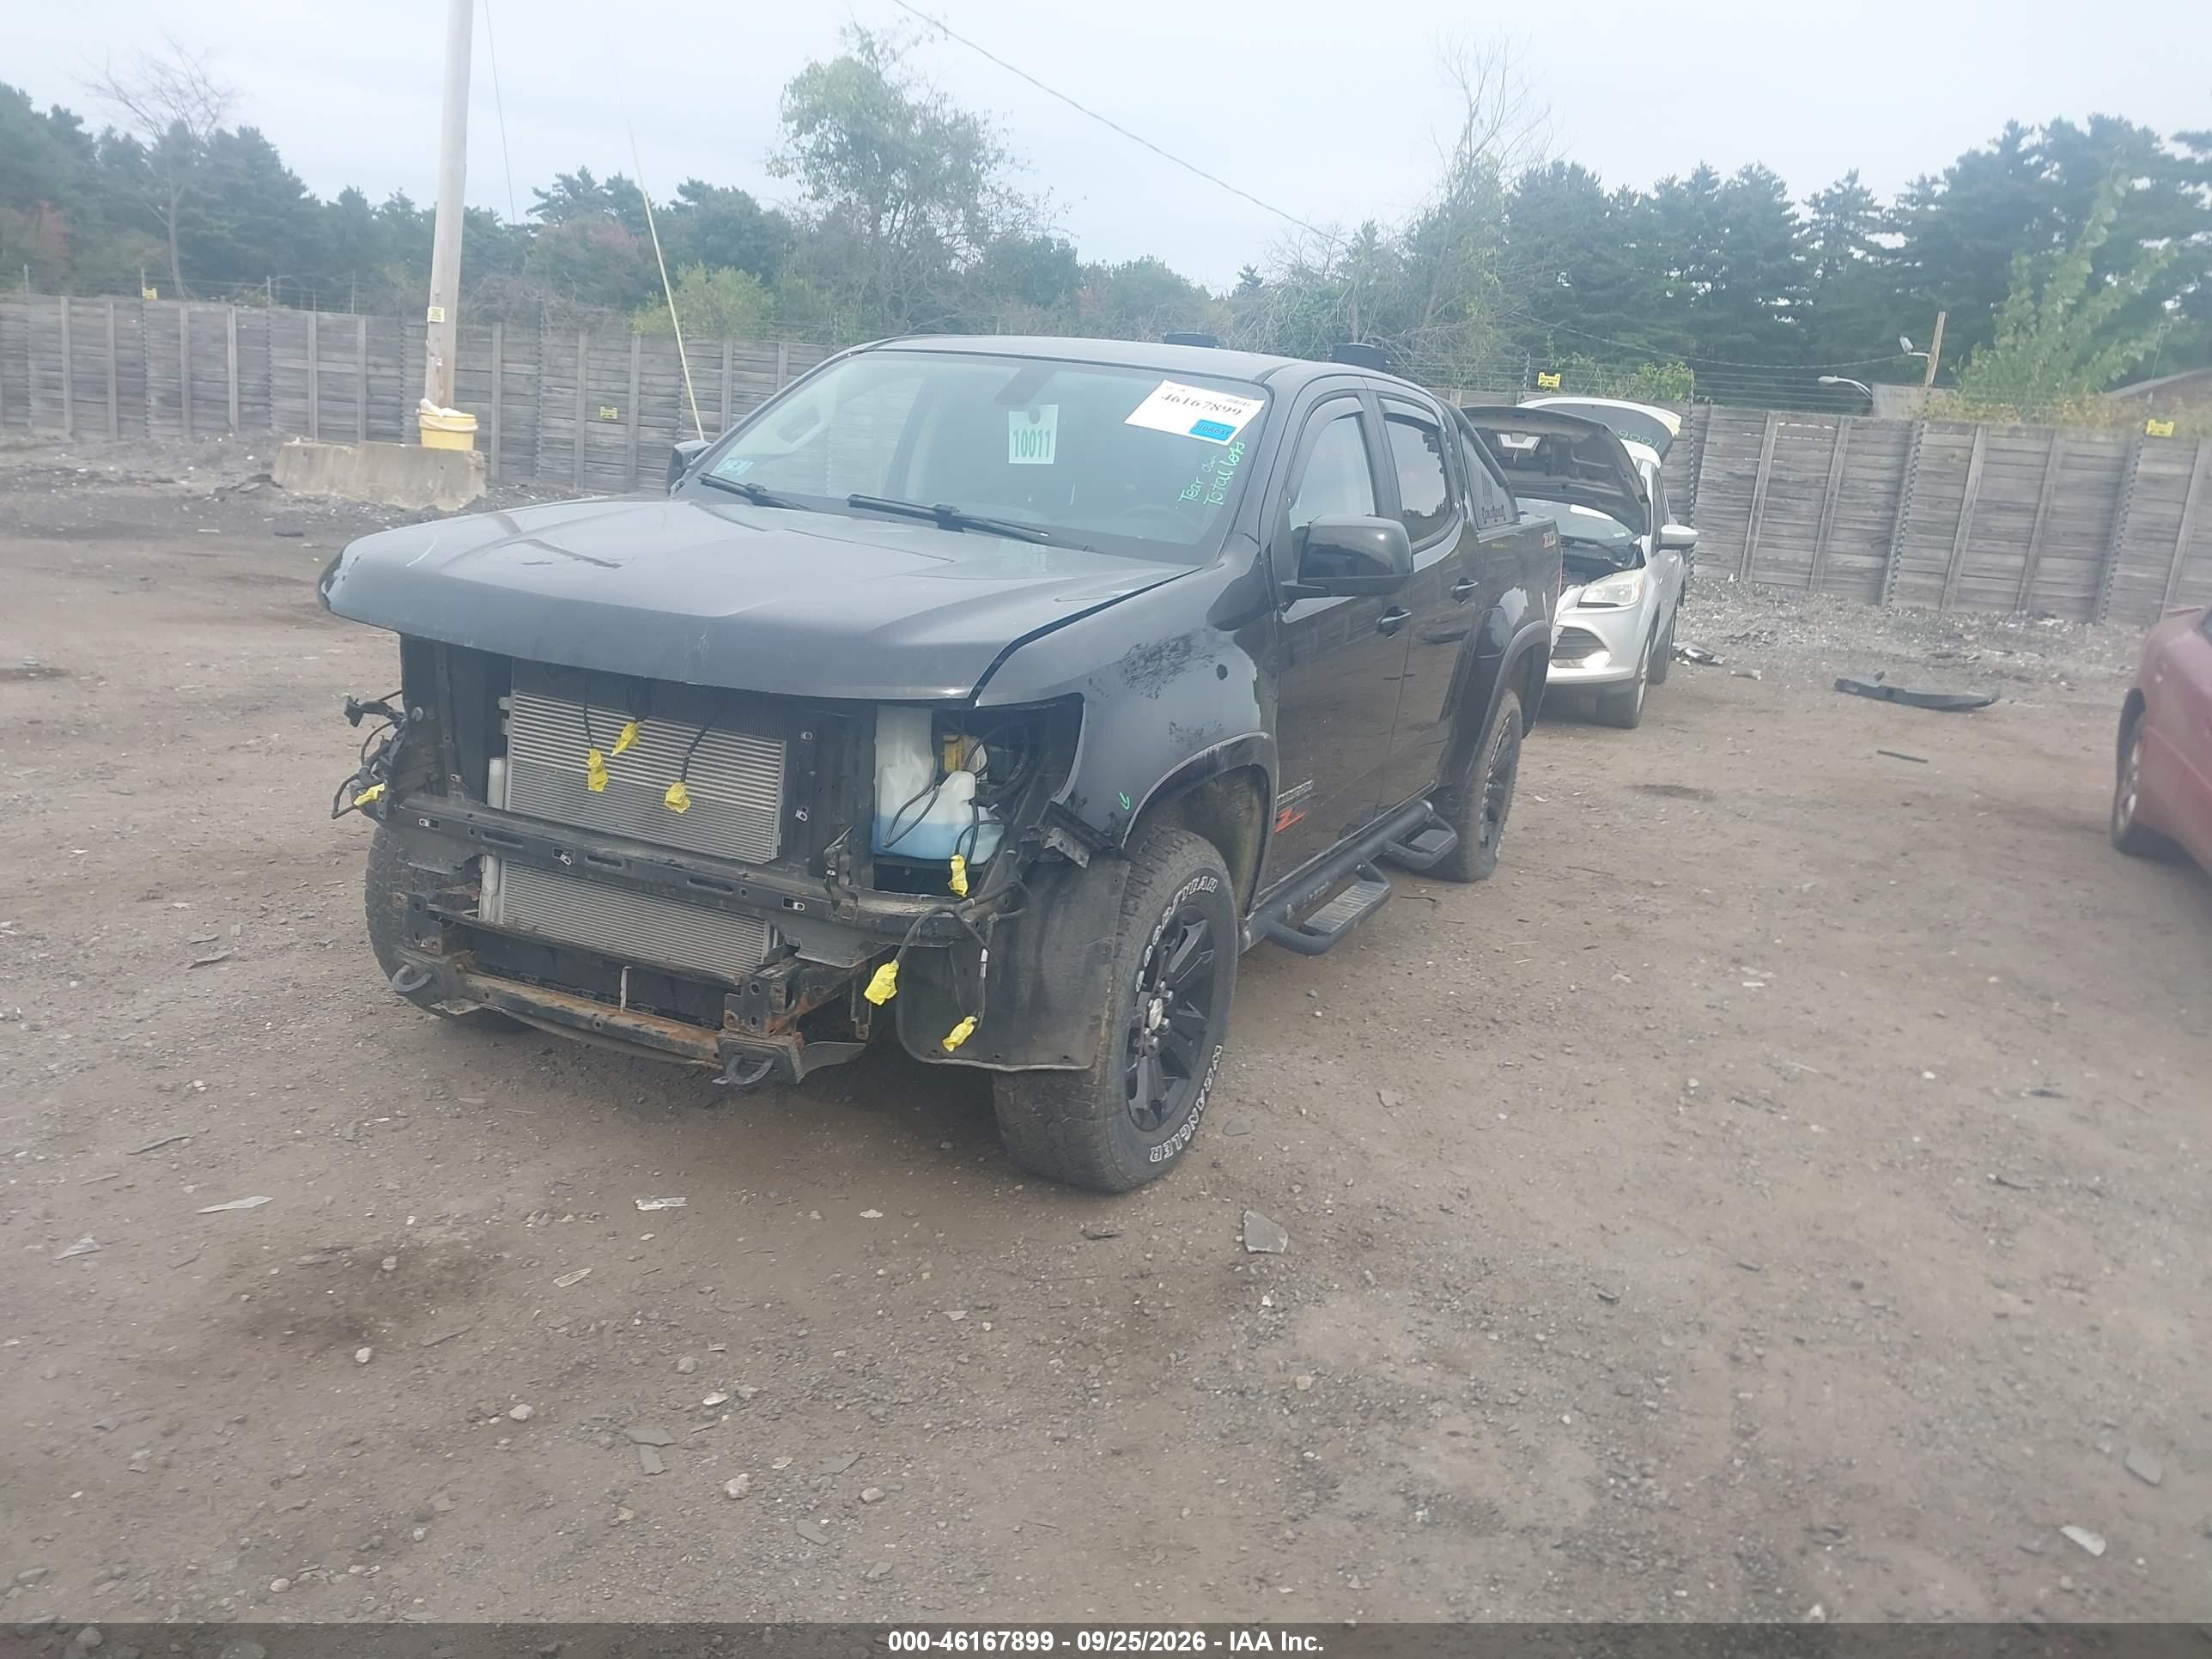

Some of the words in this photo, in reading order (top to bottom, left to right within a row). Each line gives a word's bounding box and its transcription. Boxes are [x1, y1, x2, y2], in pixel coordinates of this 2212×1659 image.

[1161, 393, 1242, 415] 46167899
[1013, 428, 1052, 459] 10011
[1149, 1044, 1223, 1163] WRANGLER
